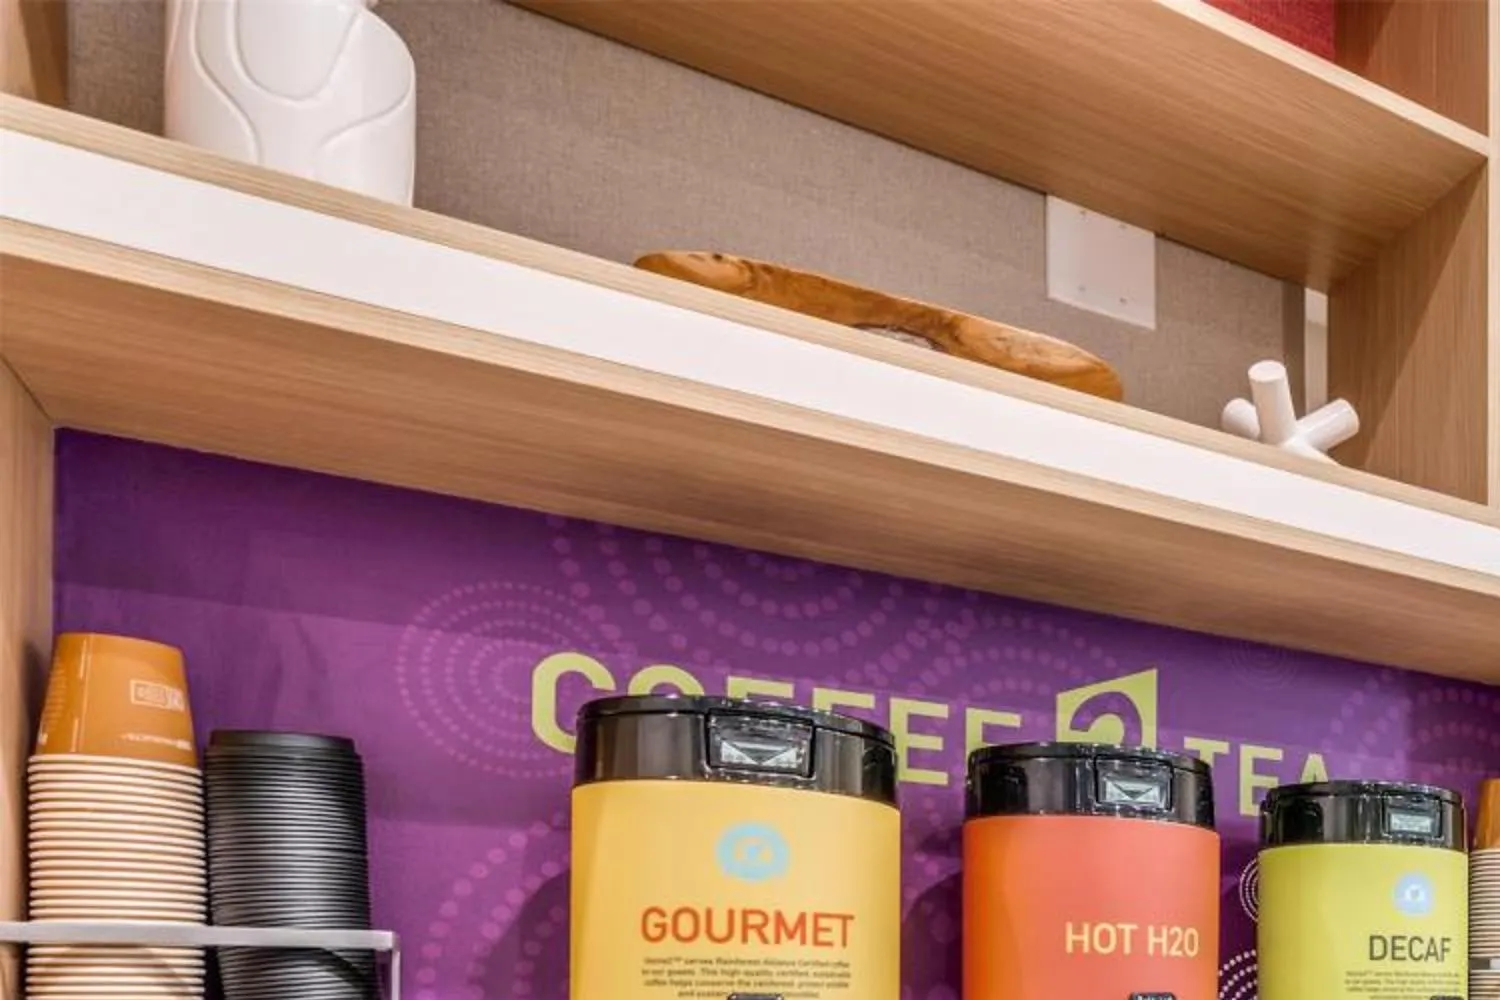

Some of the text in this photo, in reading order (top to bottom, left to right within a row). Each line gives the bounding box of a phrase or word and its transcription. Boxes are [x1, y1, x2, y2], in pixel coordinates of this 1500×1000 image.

[640, 906, 855, 948] GOURMET
[1065, 921, 1139, 955] HOT
[1369, 935, 1452, 962] DECAF
